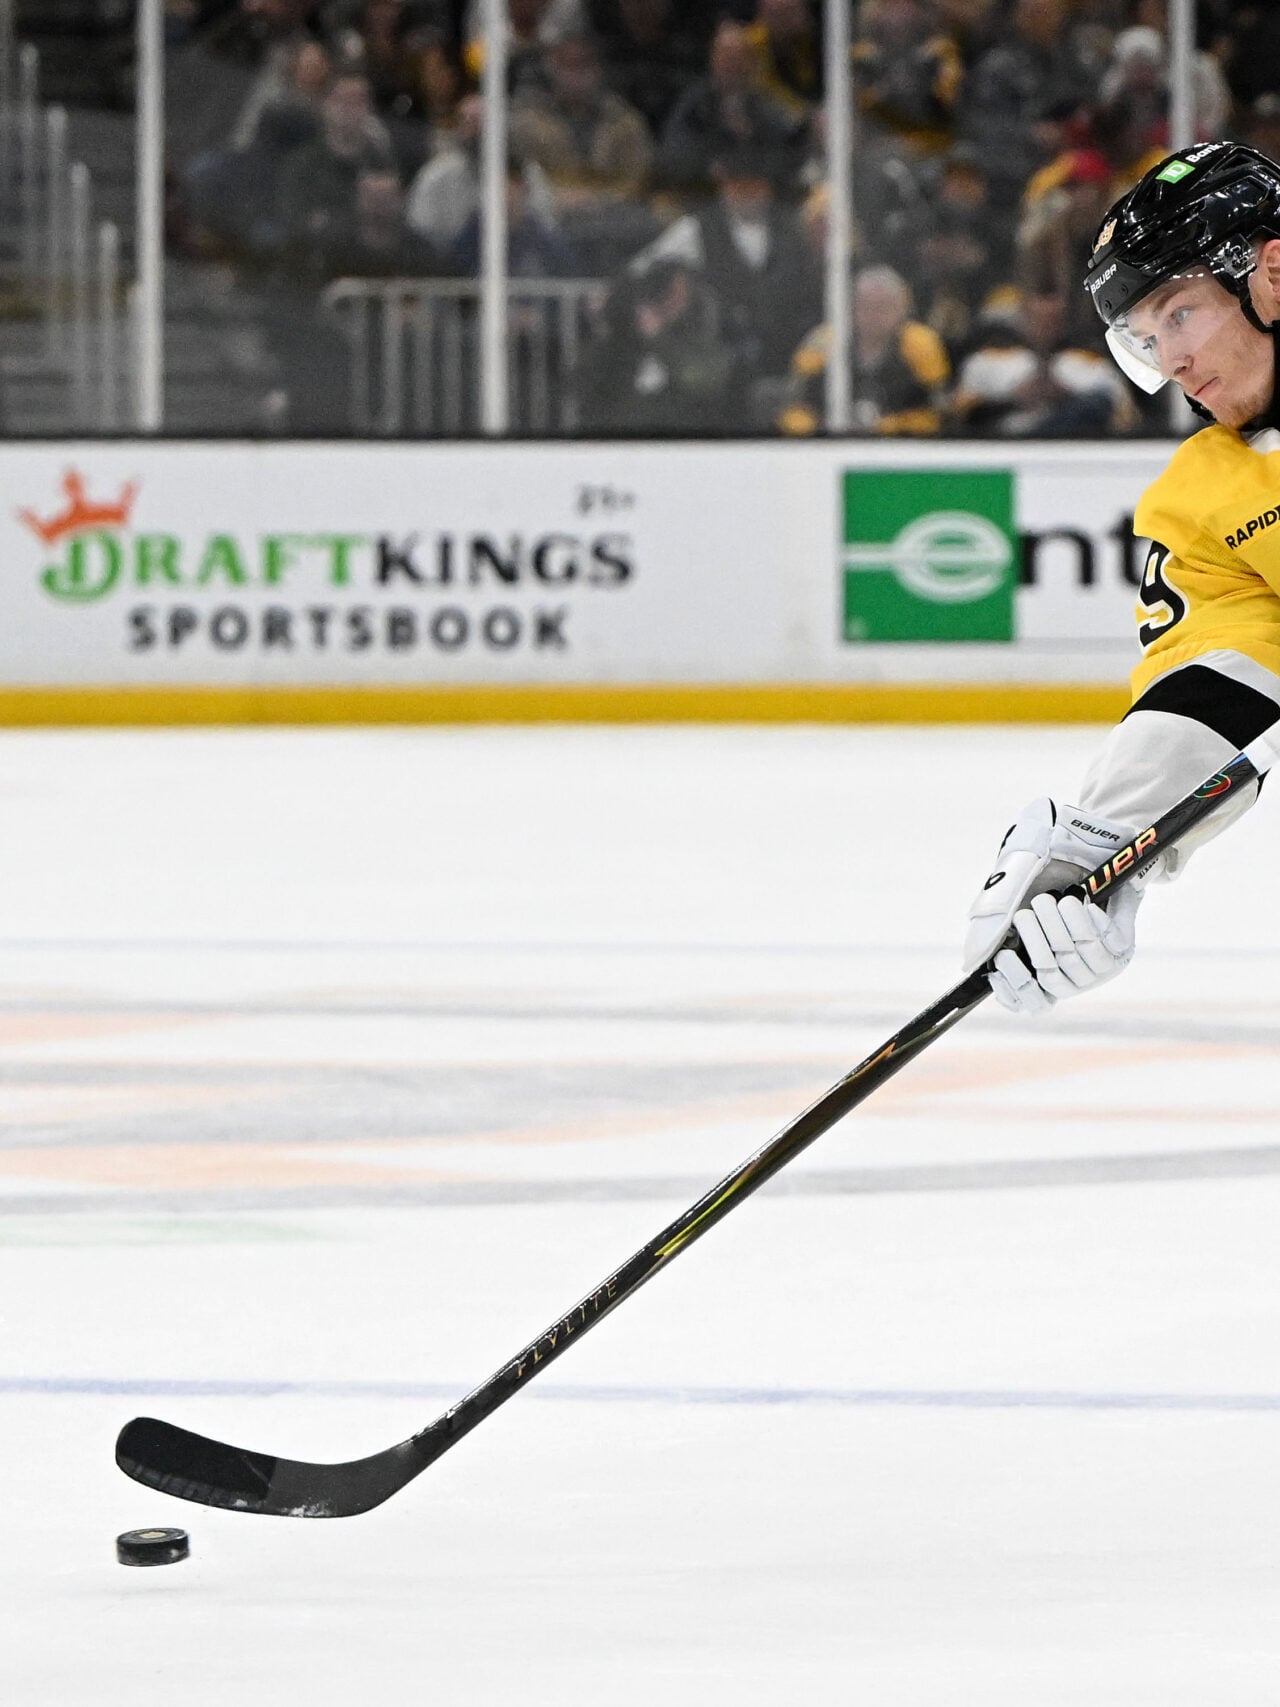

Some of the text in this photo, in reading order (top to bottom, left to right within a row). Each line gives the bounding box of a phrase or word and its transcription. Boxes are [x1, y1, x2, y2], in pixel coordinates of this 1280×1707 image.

[1090, 263, 1118, 294] BAUER
[41, 528, 635, 601] DRAFTKINGS
[127, 603, 571, 653] SPORTSBOOK
[1070, 818, 1121, 844] BAUER
[1083, 826, 1160, 896] UER
[515, 1276, 618, 1377] FLYLITE
